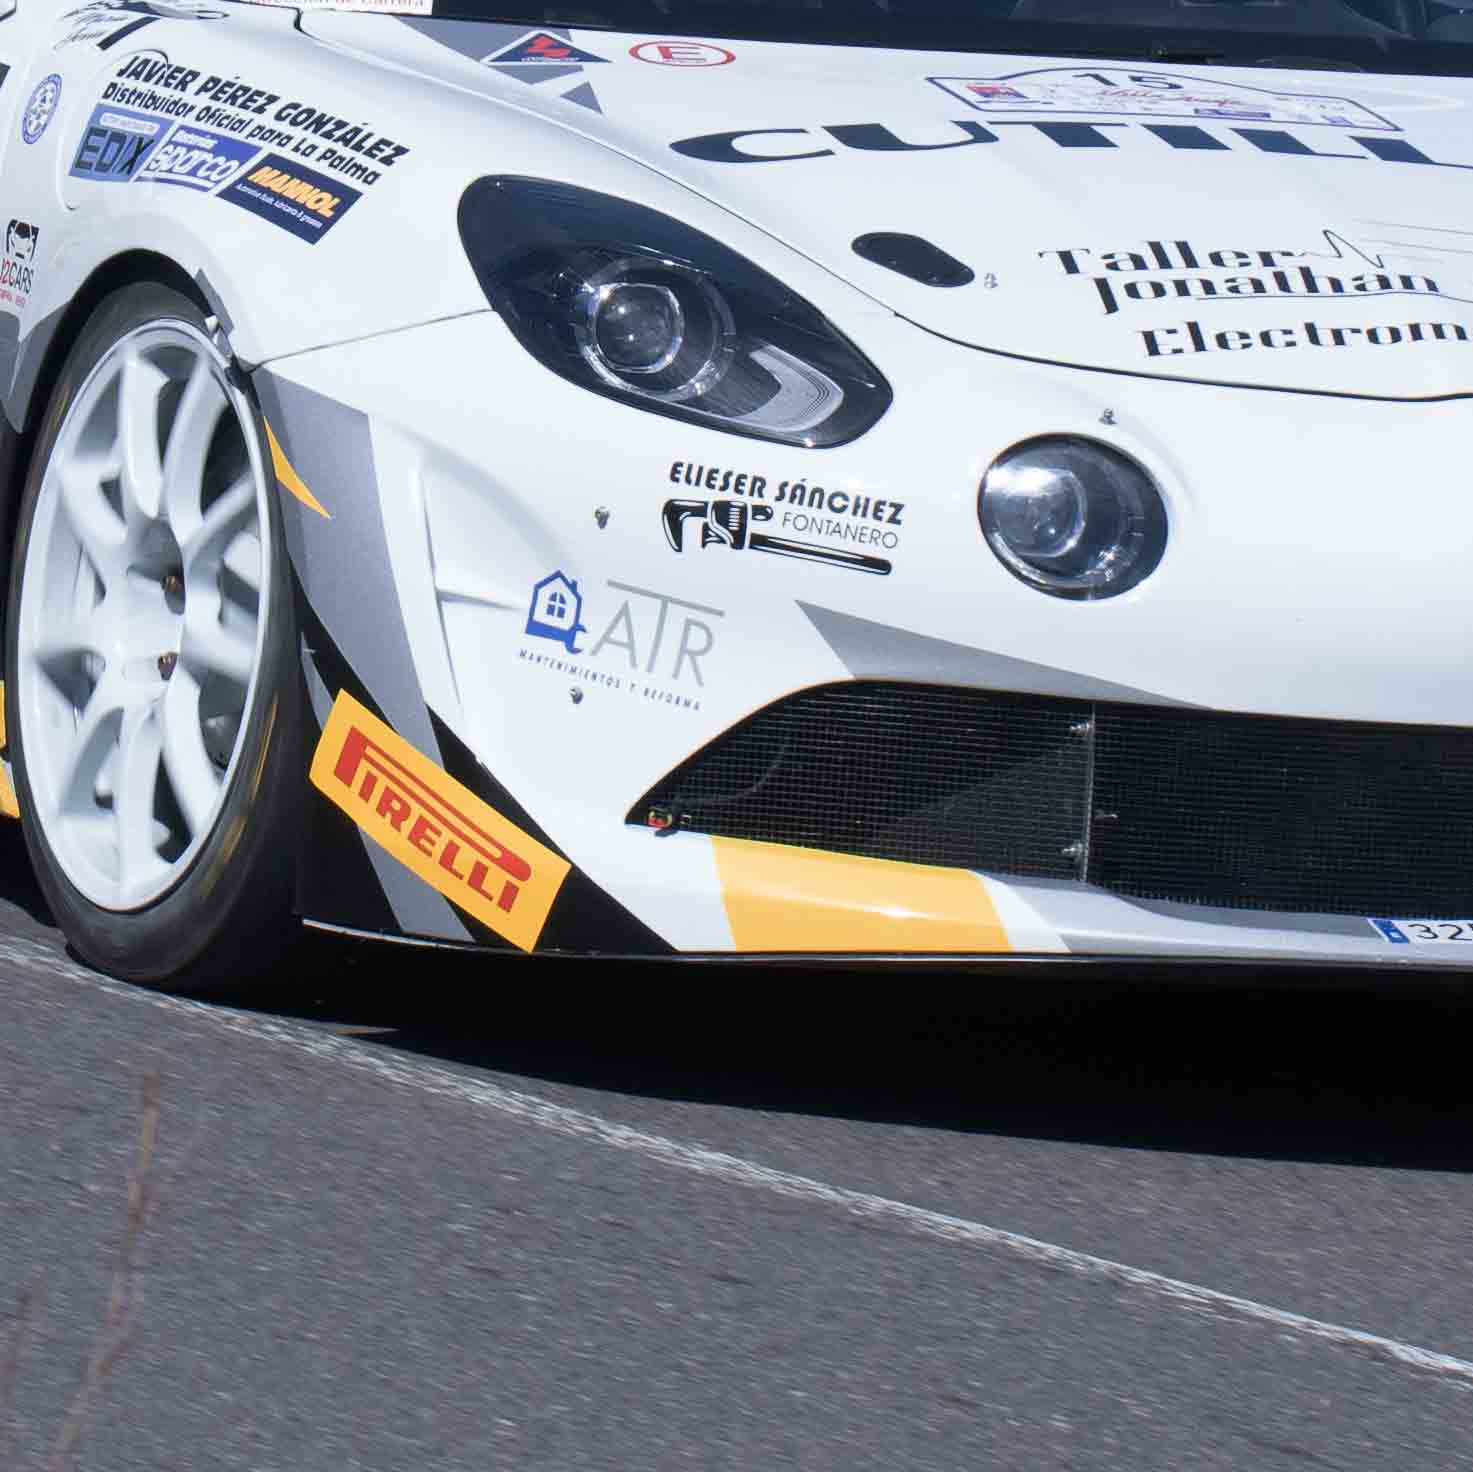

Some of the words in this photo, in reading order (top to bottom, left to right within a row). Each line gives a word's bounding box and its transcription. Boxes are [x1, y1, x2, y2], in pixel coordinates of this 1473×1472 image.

[1074, 72, 1183, 90] 15
[101, 81, 196, 120] Distribuidor
[246, 123, 290, 149] para
[315, 145, 383, 186] Palma
[116, 55, 200, 94] JAVIER
[194, 74, 281, 116] PÉREZ
[273, 102, 410, 168] GONZÁLEZ
[247, 164, 343, 219] MANNOL
[1039, 239, 1302, 276] Taller
[1085, 266, 1440, 314] Jonathan
[670, 461, 767, 499] ELIESER
[774, 478, 905, 526] SÁNCHEZ
[782, 511, 899, 550] FONTANERO
[589, 578, 726, 688] ATR
[518, 647, 622, 690] MANTENIMIENTOS
[332, 724, 532, 913] PIRELLI
